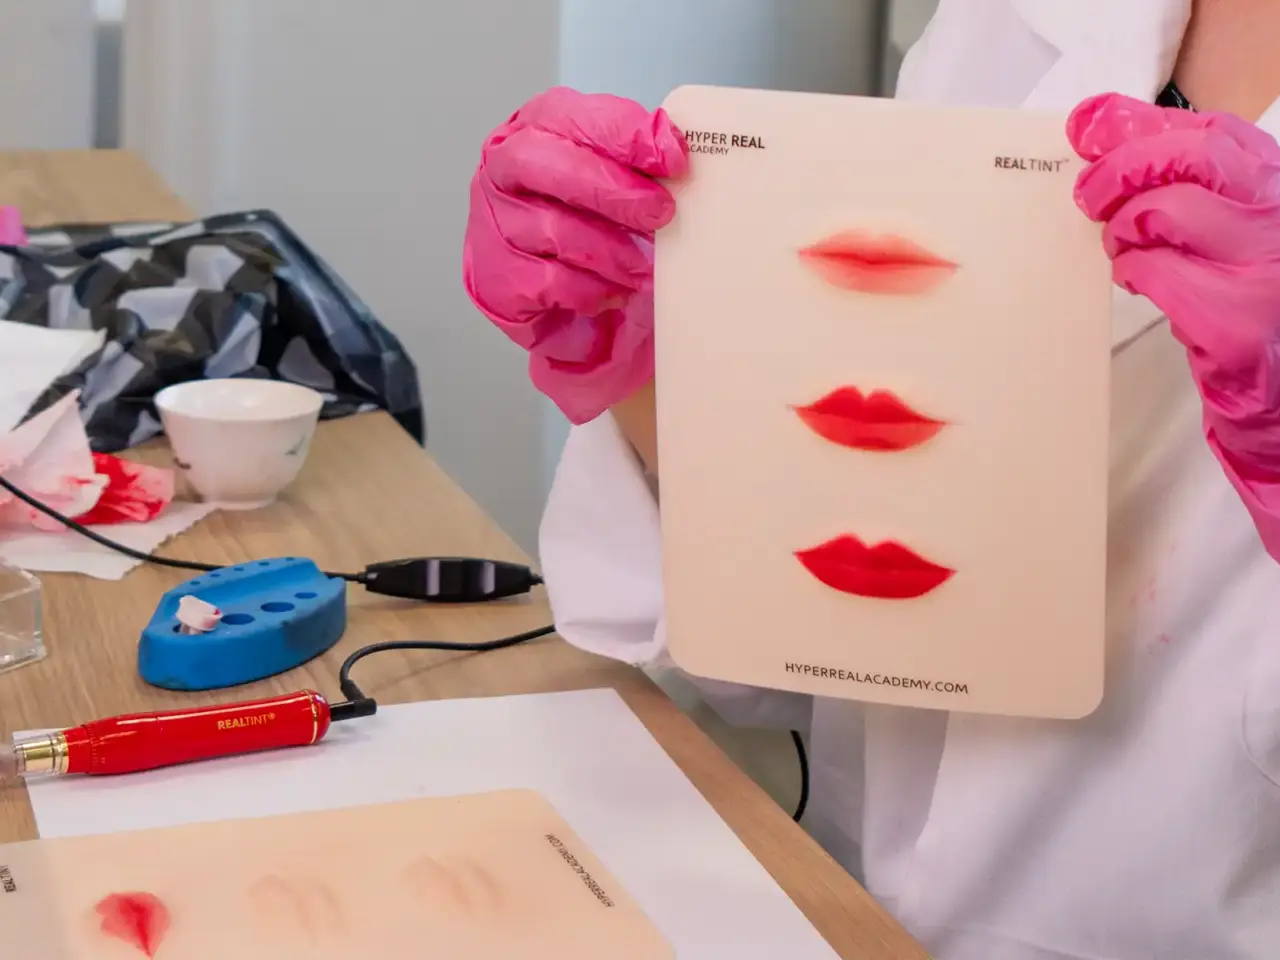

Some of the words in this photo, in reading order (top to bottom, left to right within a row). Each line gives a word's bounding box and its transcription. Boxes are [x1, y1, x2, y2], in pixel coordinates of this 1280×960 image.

[685, 130, 727, 144] HYPER
[731, 134, 765, 149] REAL
[785, 662, 969, 694] HYPERREALACADEMY.COM
